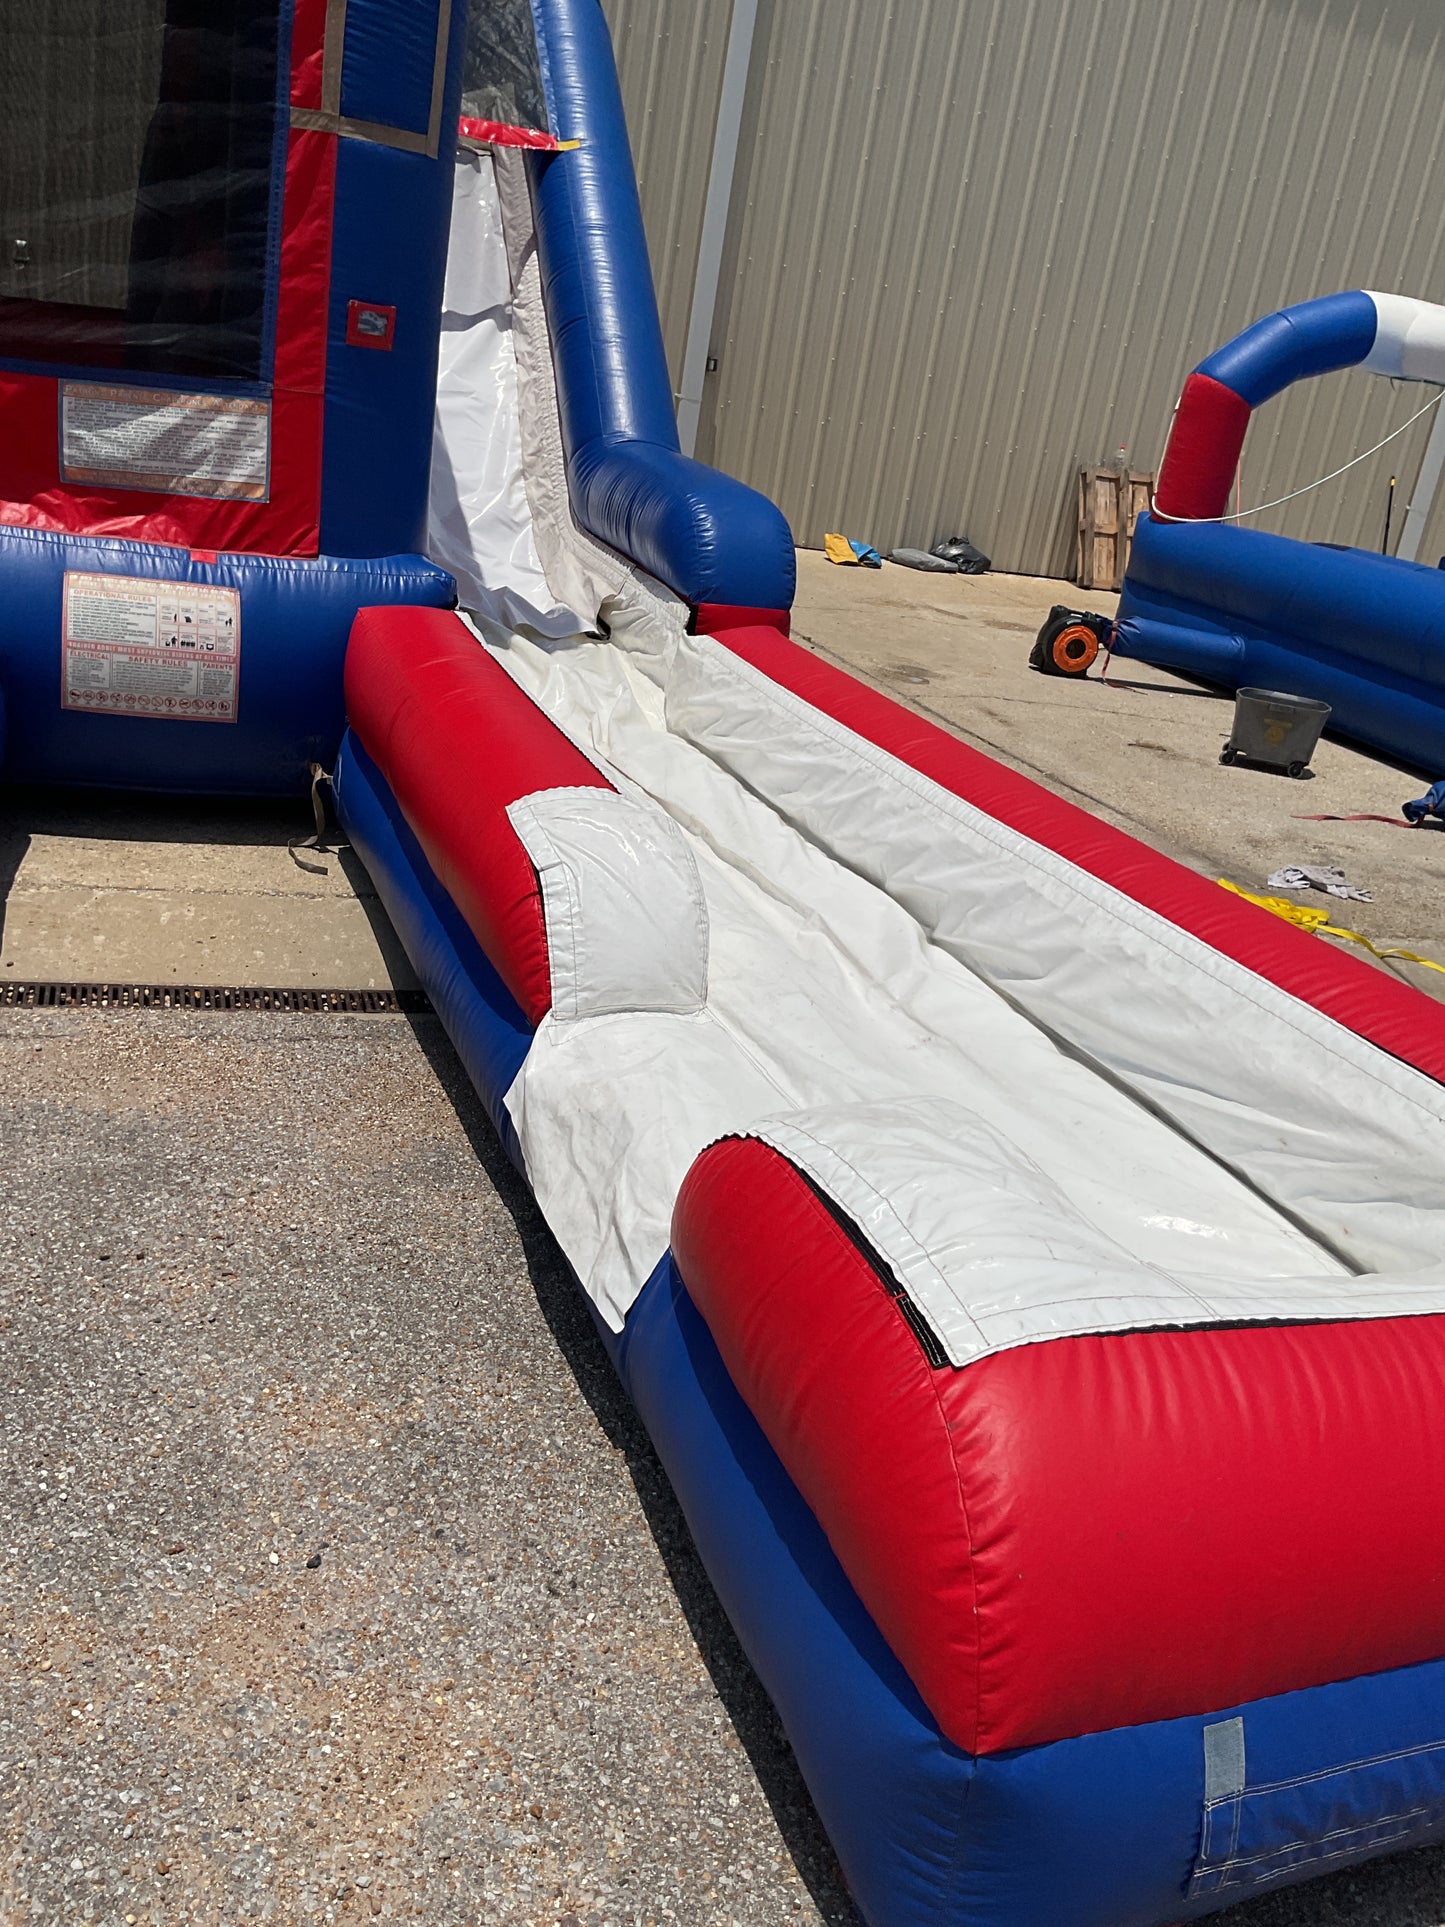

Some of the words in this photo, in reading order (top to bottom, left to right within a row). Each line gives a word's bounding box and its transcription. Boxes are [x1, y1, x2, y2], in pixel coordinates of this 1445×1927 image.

[74, 589, 126, 599] OPERATIONAL
[70, 650, 109, 660] ELECTRICAL
[128, 656, 159, 664] SAFETY
[162, 659, 188, 668] RULES
[203, 662, 233, 671] PARENTS
